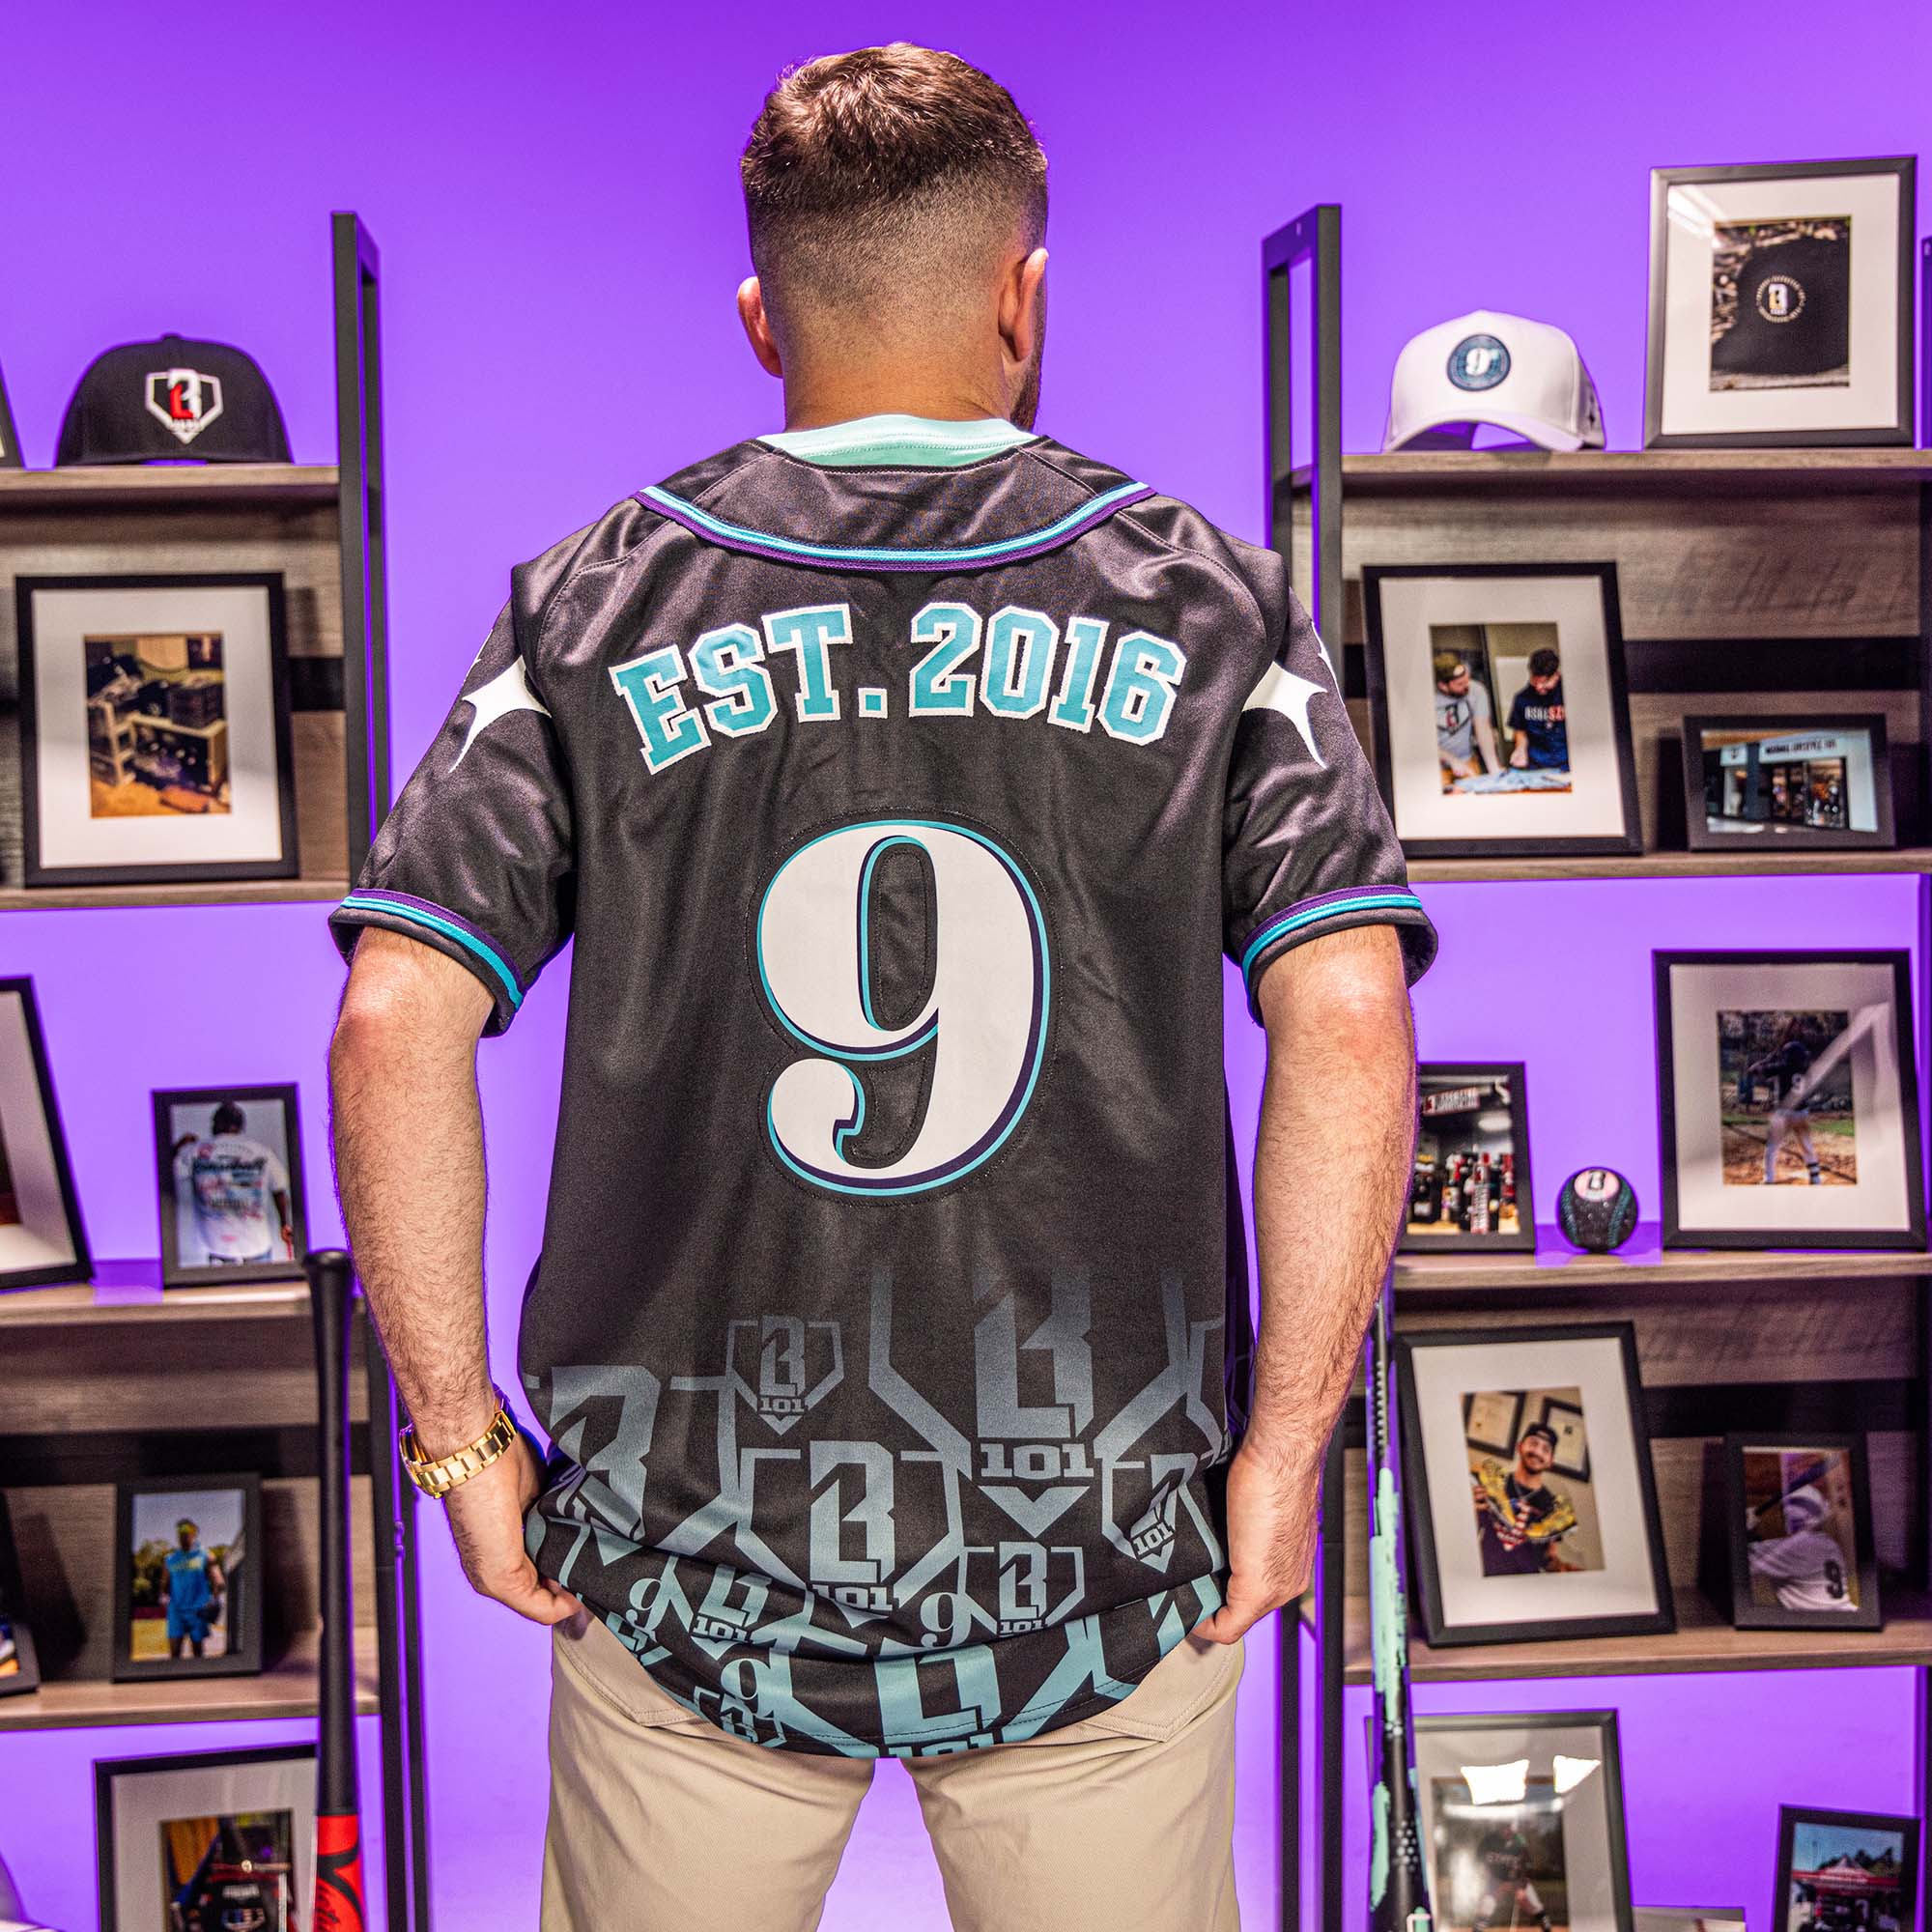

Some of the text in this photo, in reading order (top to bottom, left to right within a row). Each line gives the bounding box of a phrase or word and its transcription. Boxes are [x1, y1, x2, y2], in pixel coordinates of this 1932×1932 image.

[608, 601, 1188, 776] EST. 2016
[756, 819, 1051, 1197] 9
[758, 1397, 806, 1413] 101
[980, 1442, 1095, 1481] 101
[1131, 1520, 1175, 1556] 101
[1823, 1559, 1844, 1600] 9
[692, 1615, 749, 1642] 101
[919, 1591, 973, 1649] 9
[998, 1619, 1045, 1634] 101
